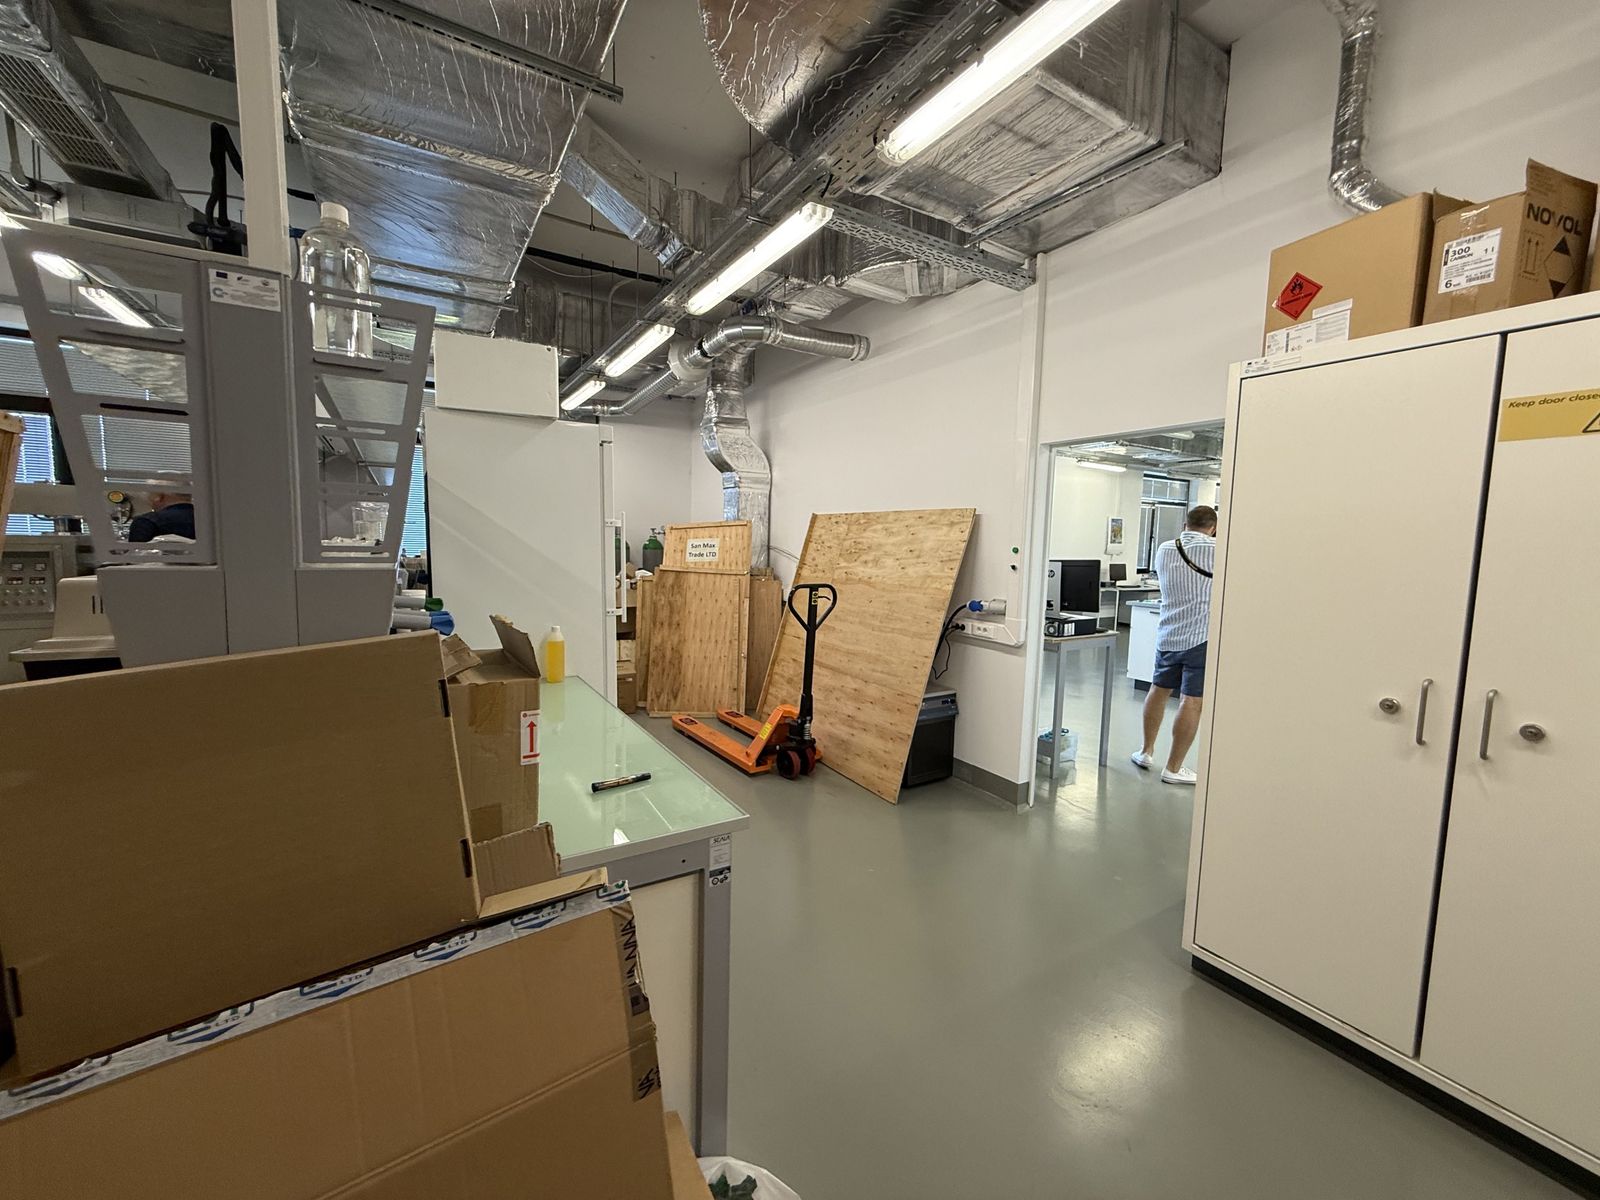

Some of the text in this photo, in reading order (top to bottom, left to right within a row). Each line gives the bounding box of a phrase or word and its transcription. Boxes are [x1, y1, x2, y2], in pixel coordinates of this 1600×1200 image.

[1450, 246, 1470, 257] 300
[1444, 279, 1453, 289] 6
[1508, 393, 1600, 409] Keep door close
